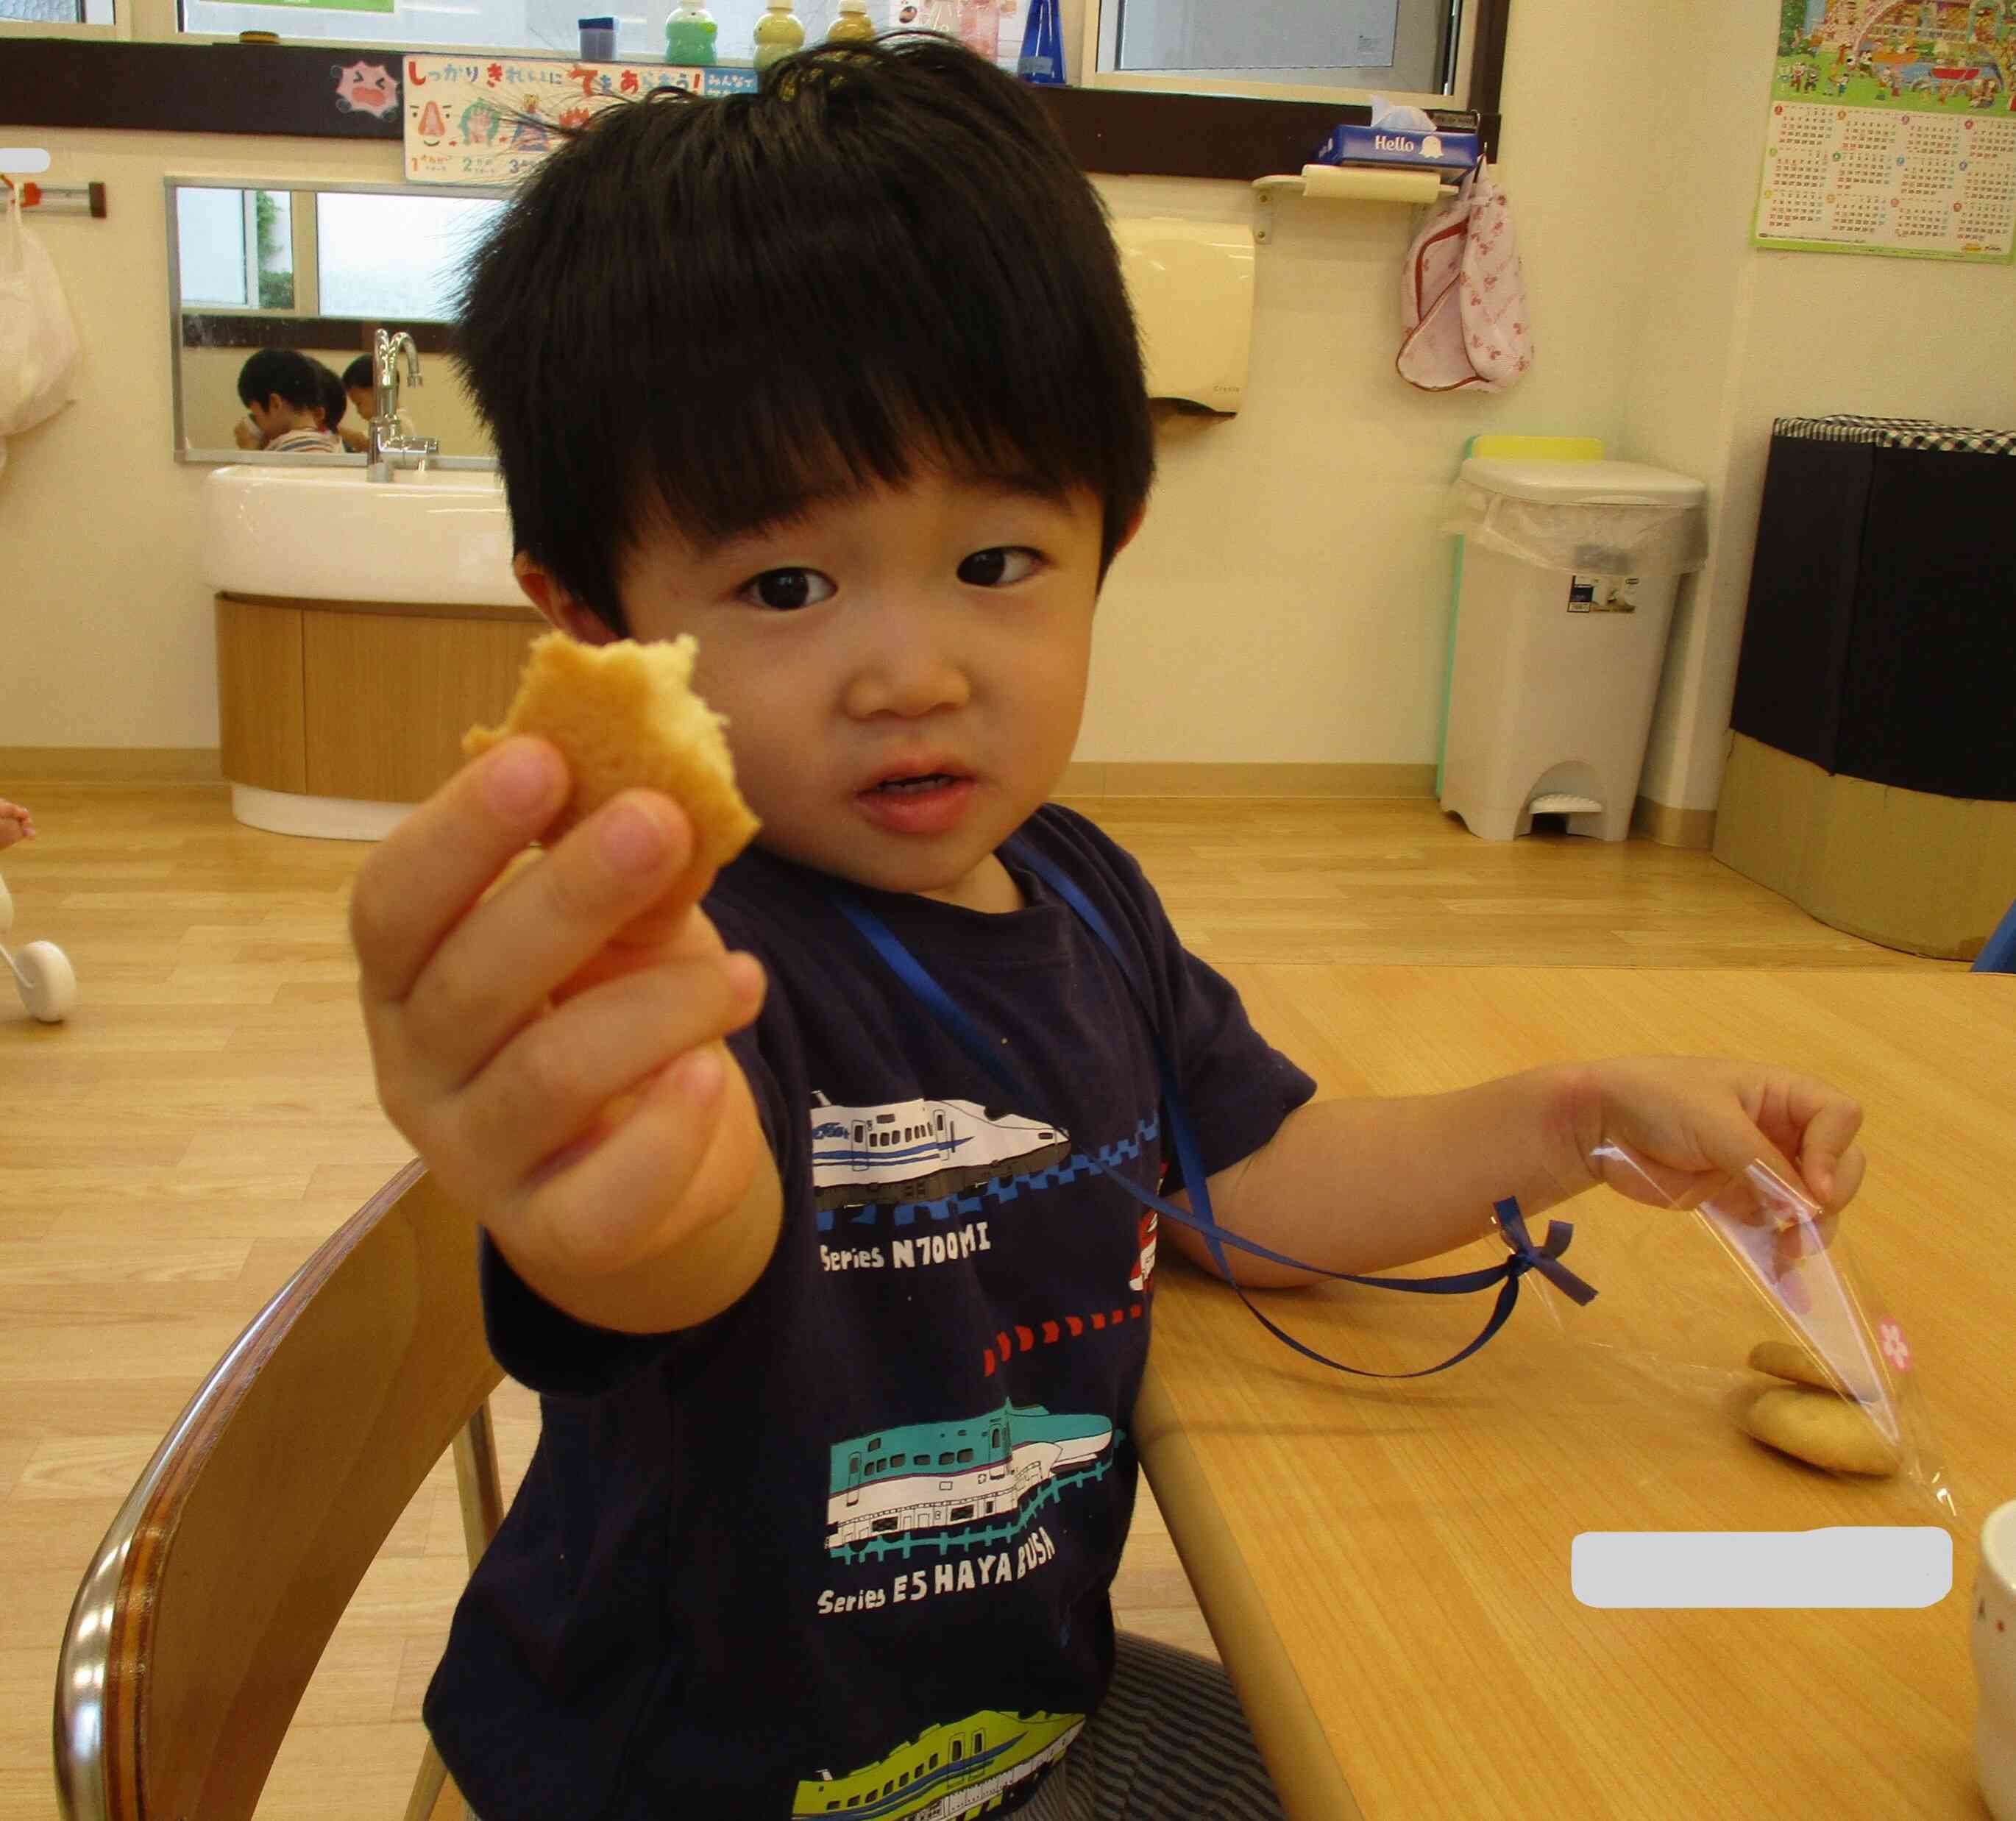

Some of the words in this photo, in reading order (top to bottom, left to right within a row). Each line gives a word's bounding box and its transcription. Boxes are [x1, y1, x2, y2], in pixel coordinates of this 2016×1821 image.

[1374, 135, 1414, 154] Hello
[820, 1244, 884, 1271] Series
[817, 1589, 886, 1614] Series
[892, 1570, 928, 1603] E5
[934, 1526, 1056, 1594] HAYABUSA
